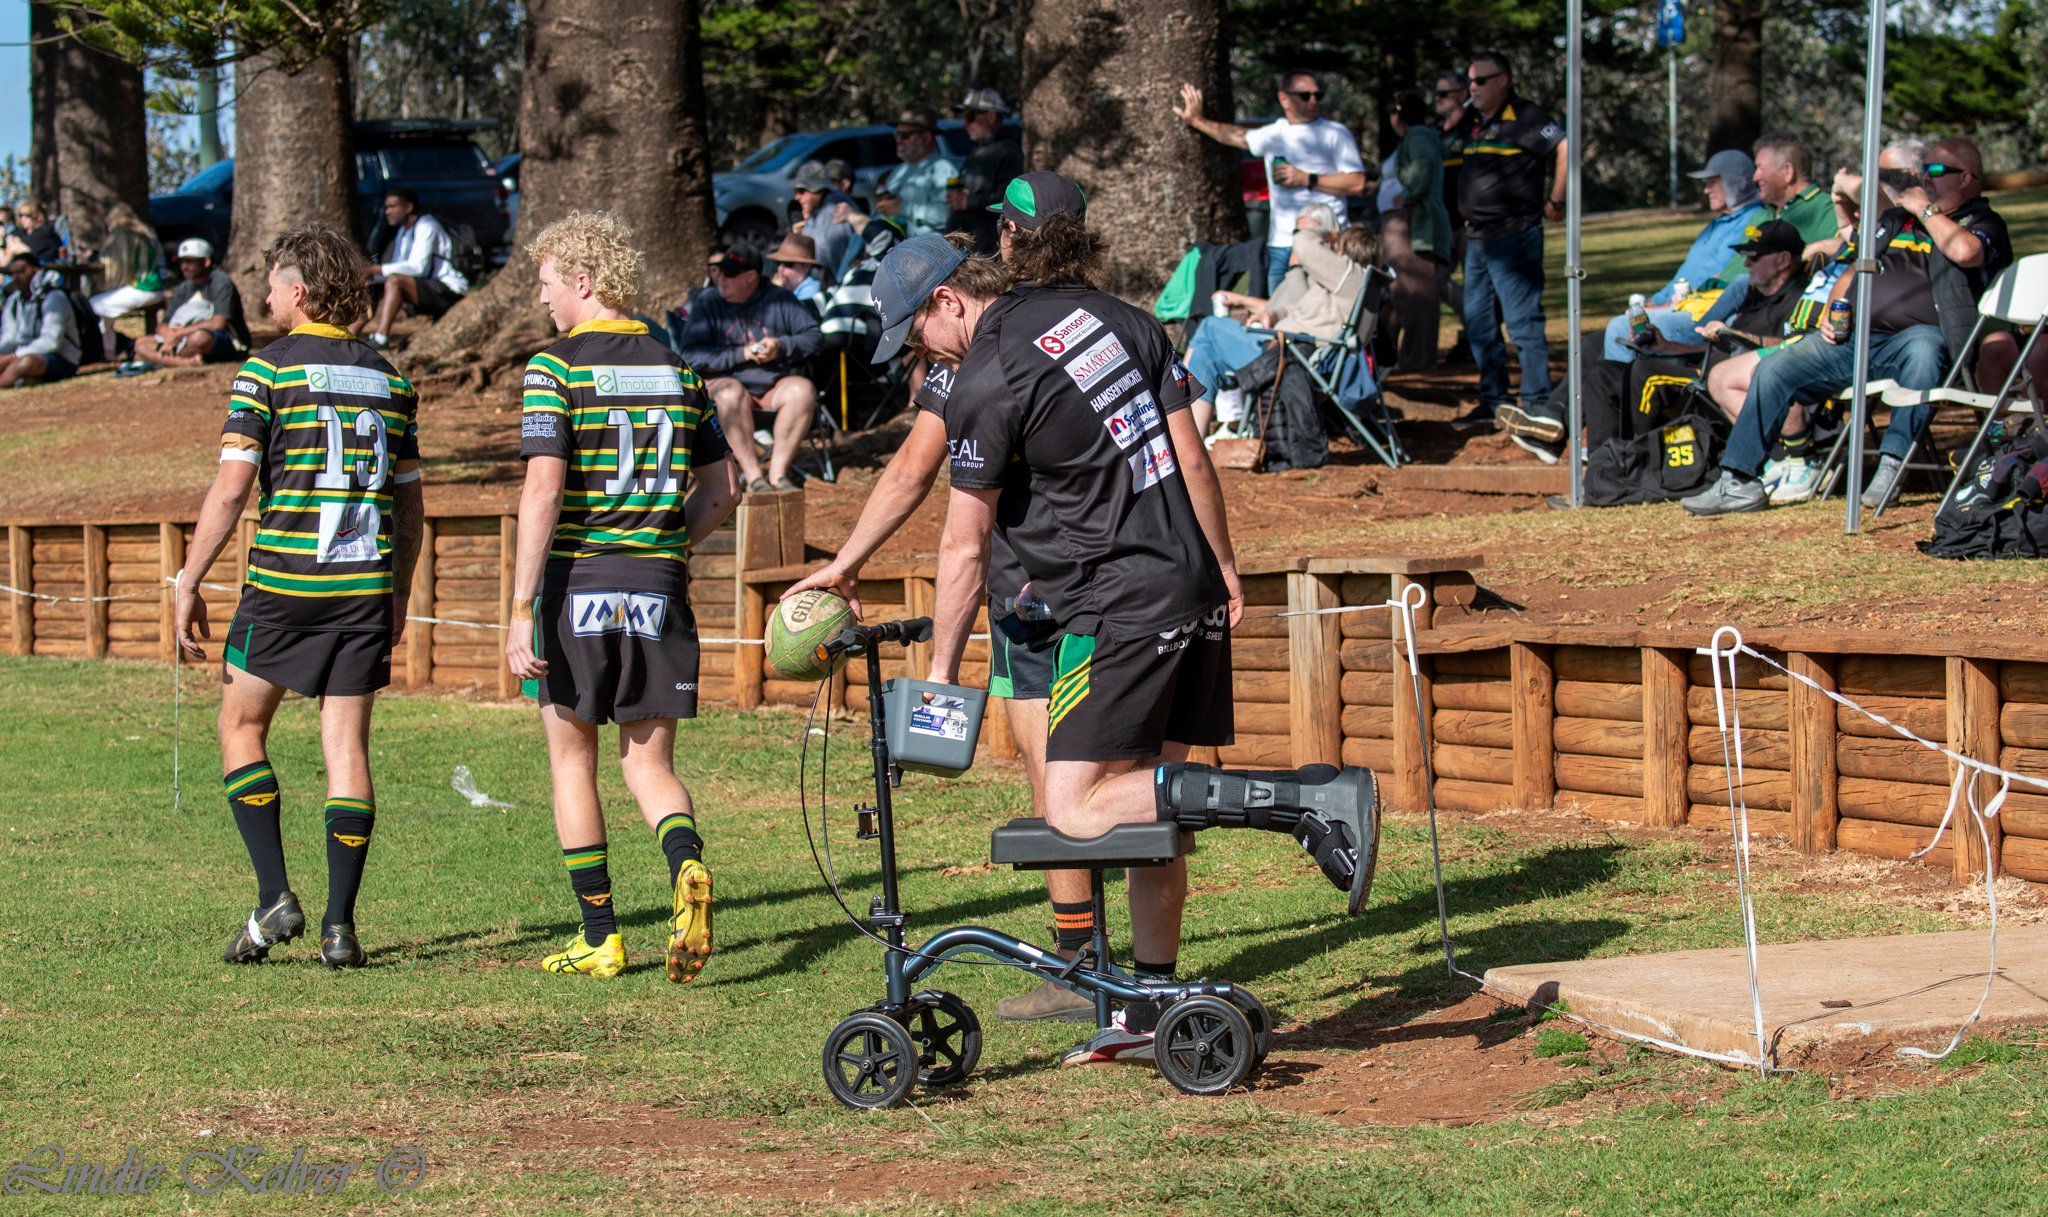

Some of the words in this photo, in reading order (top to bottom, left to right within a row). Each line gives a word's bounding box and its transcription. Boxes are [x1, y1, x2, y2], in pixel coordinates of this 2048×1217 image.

[1054, 312, 1092, 340] Sansons
[1073, 341, 1123, 383] SMARTER
[333, 378, 370, 391] motor
[373, 378, 389, 393] inn
[620, 378, 660, 391] motor
[540, 422, 554, 430] and
[314, 405, 388, 491] 13
[604, 408, 678, 495] 11
[1667, 444, 1694, 468] 35
[962, 461, 985, 469] GROUP
